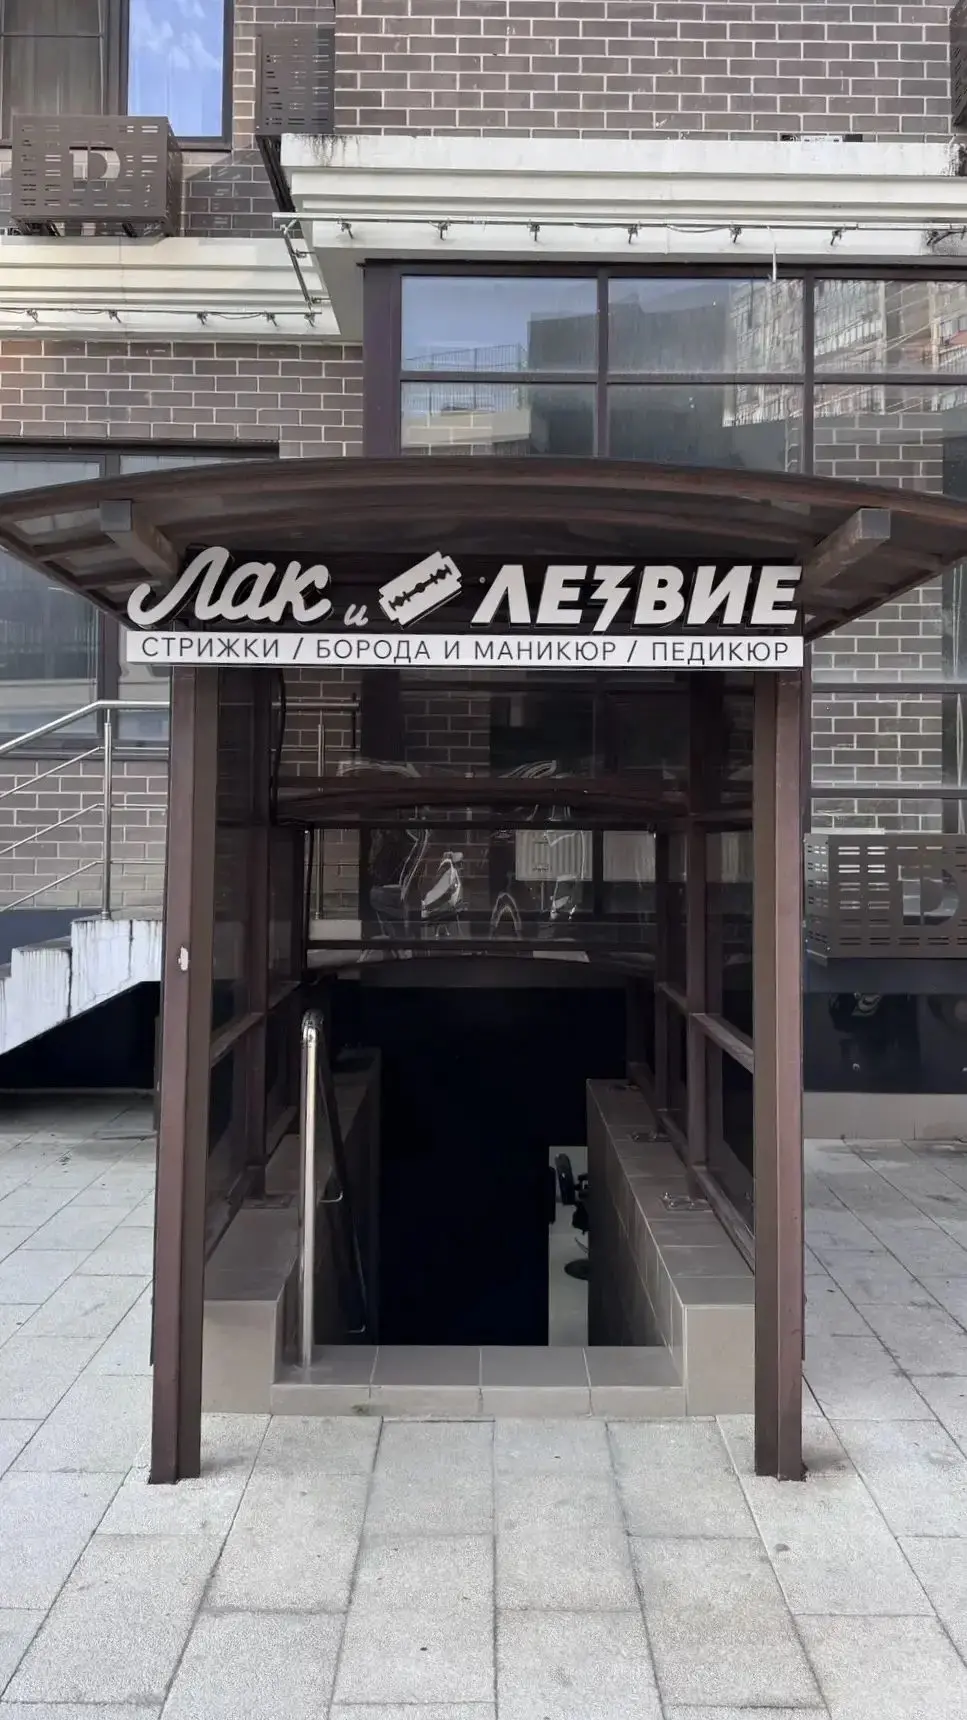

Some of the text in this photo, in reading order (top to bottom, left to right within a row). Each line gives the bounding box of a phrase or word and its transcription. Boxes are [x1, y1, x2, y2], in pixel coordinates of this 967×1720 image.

[127, 546, 332, 625] Лак
[343, 604, 369, 626] и
[141, 637, 280, 658] СТРИЖКИ
[316, 639, 430, 663] БОРОДА
[444, 641, 461, 660] И
[474, 641, 617, 661] МАНИКЮР
[651, 641, 788, 665] ПЕДИКЮР
